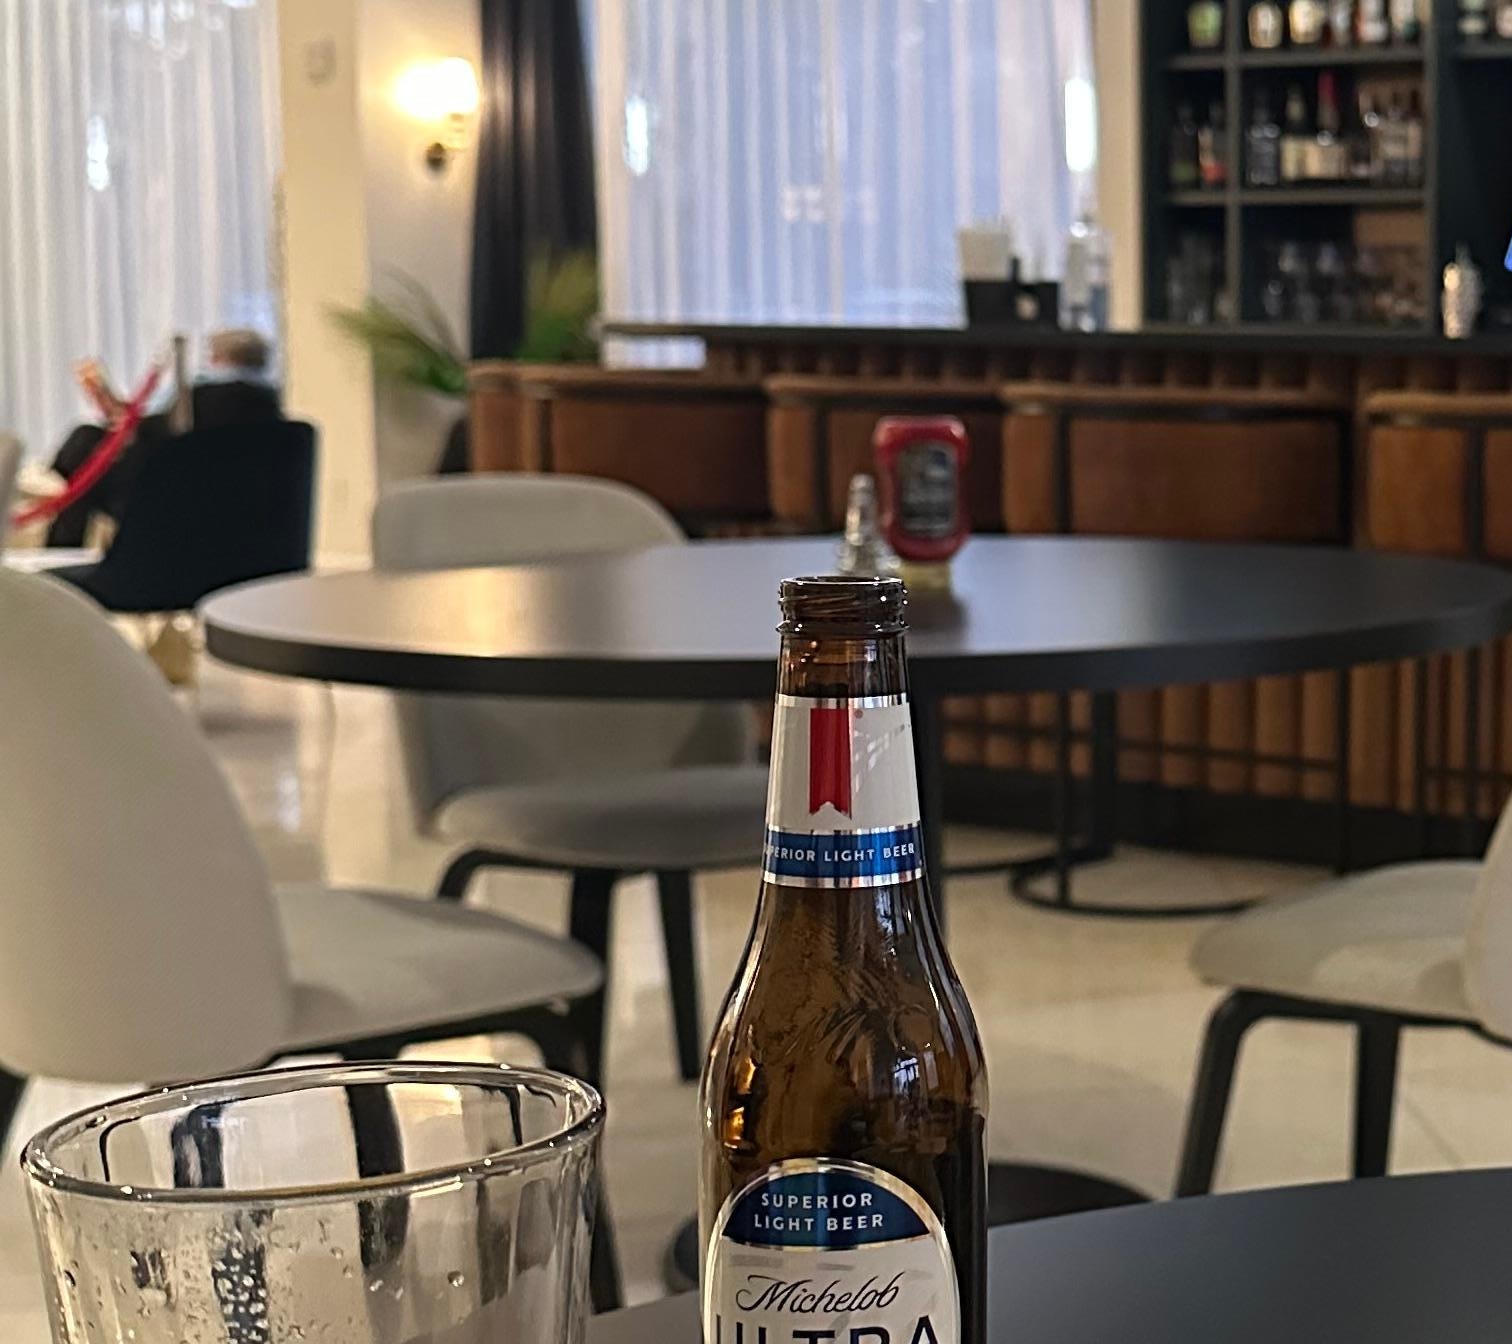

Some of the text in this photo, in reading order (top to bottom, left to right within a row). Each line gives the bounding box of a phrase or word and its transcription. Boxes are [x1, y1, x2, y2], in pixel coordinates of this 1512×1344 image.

[766, 842, 915, 863] PERIOR LIGHT BEER
[761, 1193, 873, 1209] SUPERIOR
[754, 1214, 884, 1232] LIGHT BEER
[735, 1271, 906, 1314] Michelob
